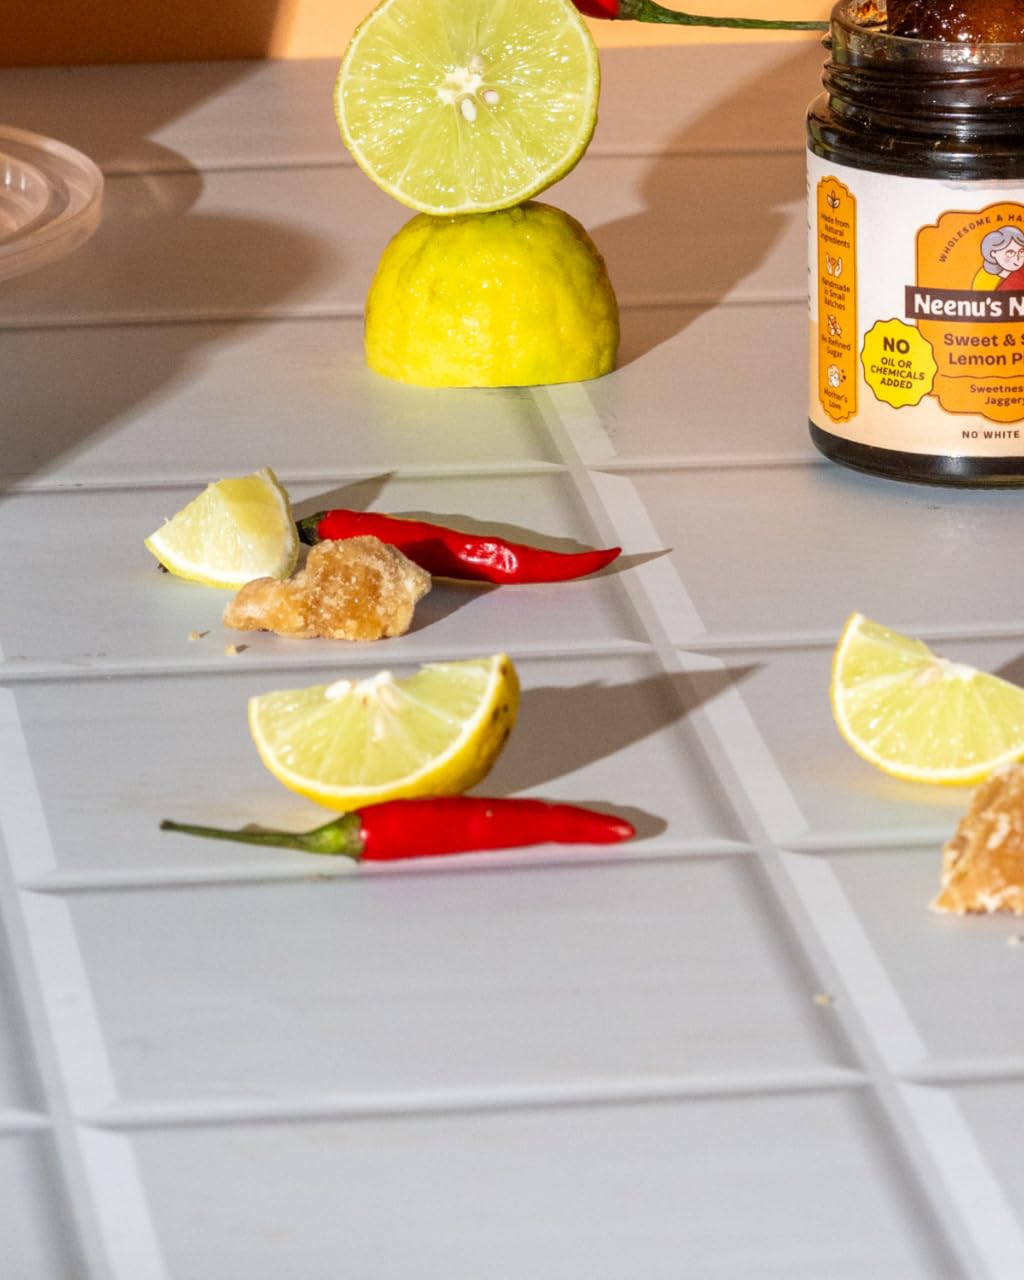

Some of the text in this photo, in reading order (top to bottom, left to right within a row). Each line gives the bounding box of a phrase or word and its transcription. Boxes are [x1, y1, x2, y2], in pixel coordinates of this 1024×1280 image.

[939, 216, 991, 263] WHOLESOME
[914, 293, 1002, 317] Neenu's
[883, 336, 910, 354] NO
[943, 333, 999, 347] Sweet
[1003, 334, 1016, 347] &
[881, 357, 912, 369] OIL OR
[949, 353, 1007, 366] Lemon
[870, 365, 925, 380] CHEMICALS
[880, 377, 913, 389] ADDED
[962, 430, 978, 439] NO
[983, 430, 1020, 439] WHITE
